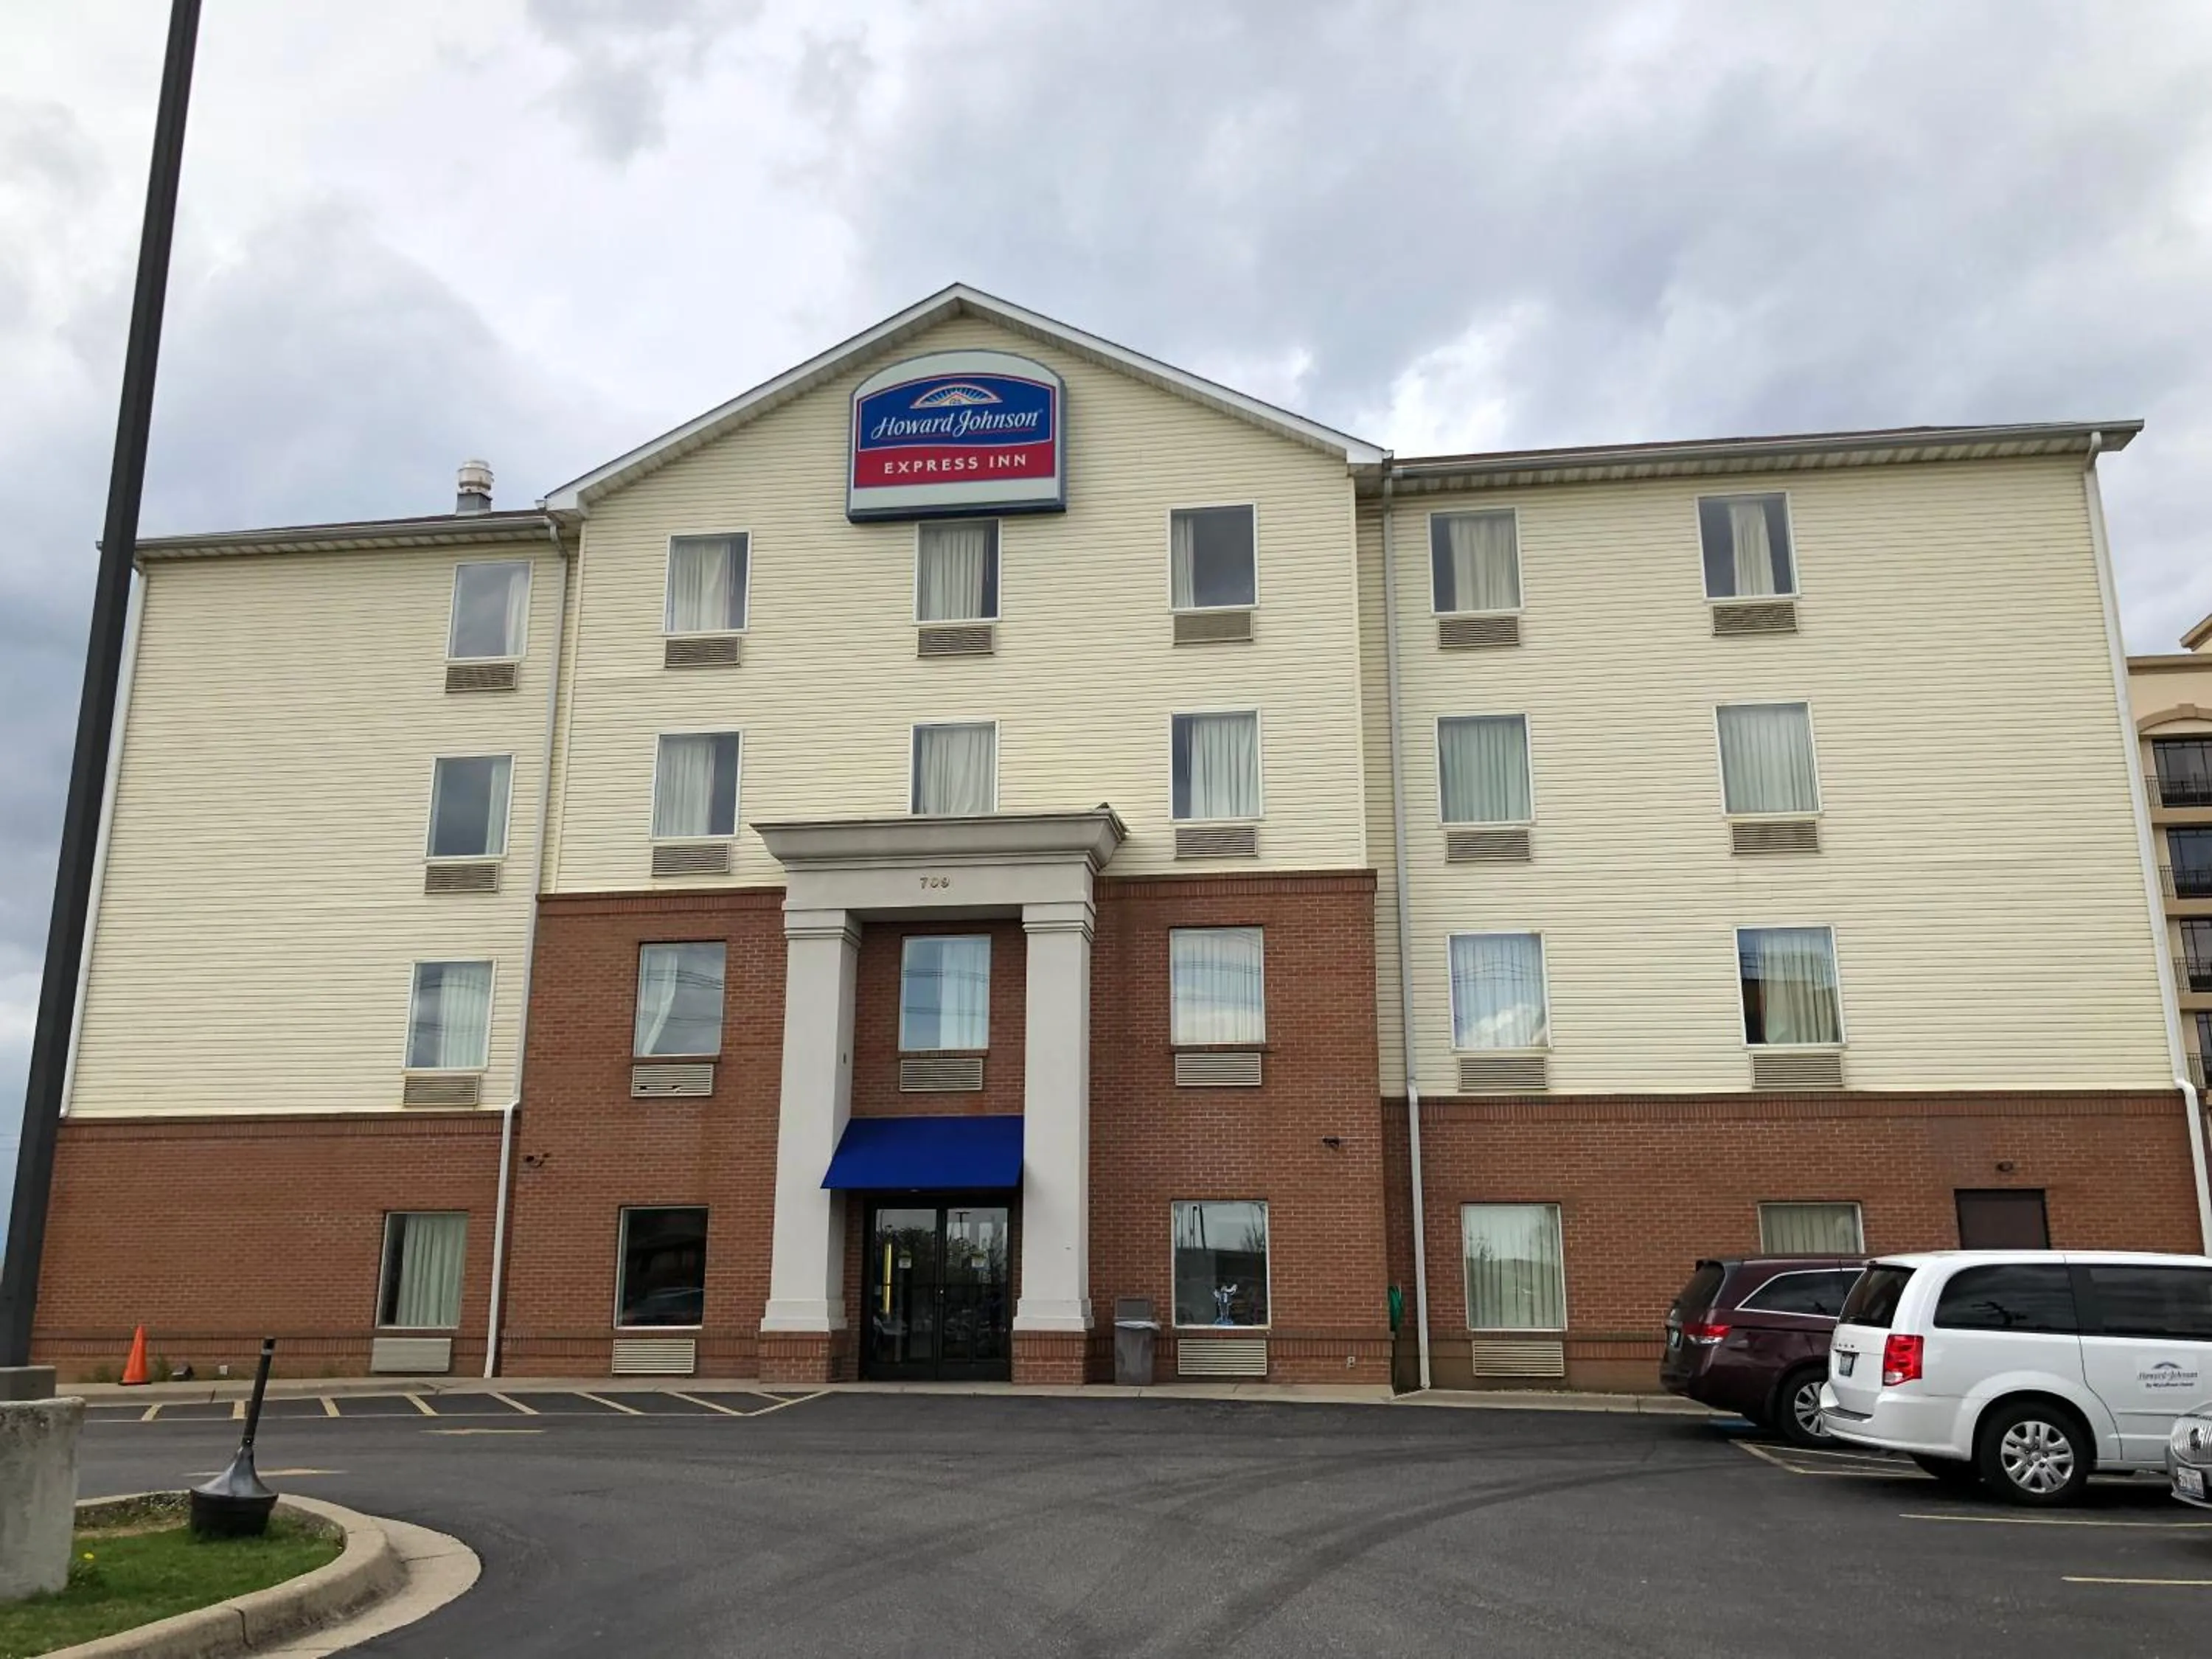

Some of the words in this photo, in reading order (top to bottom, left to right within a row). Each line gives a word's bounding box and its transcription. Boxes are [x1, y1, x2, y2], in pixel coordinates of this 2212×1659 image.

[871, 412, 955, 440] Howard
[952, 408, 1039, 437] Johnson
[884, 456, 978, 475] EXPRESS
[989, 453, 1027, 469] INN
[919, 876, 950, 889] 709
